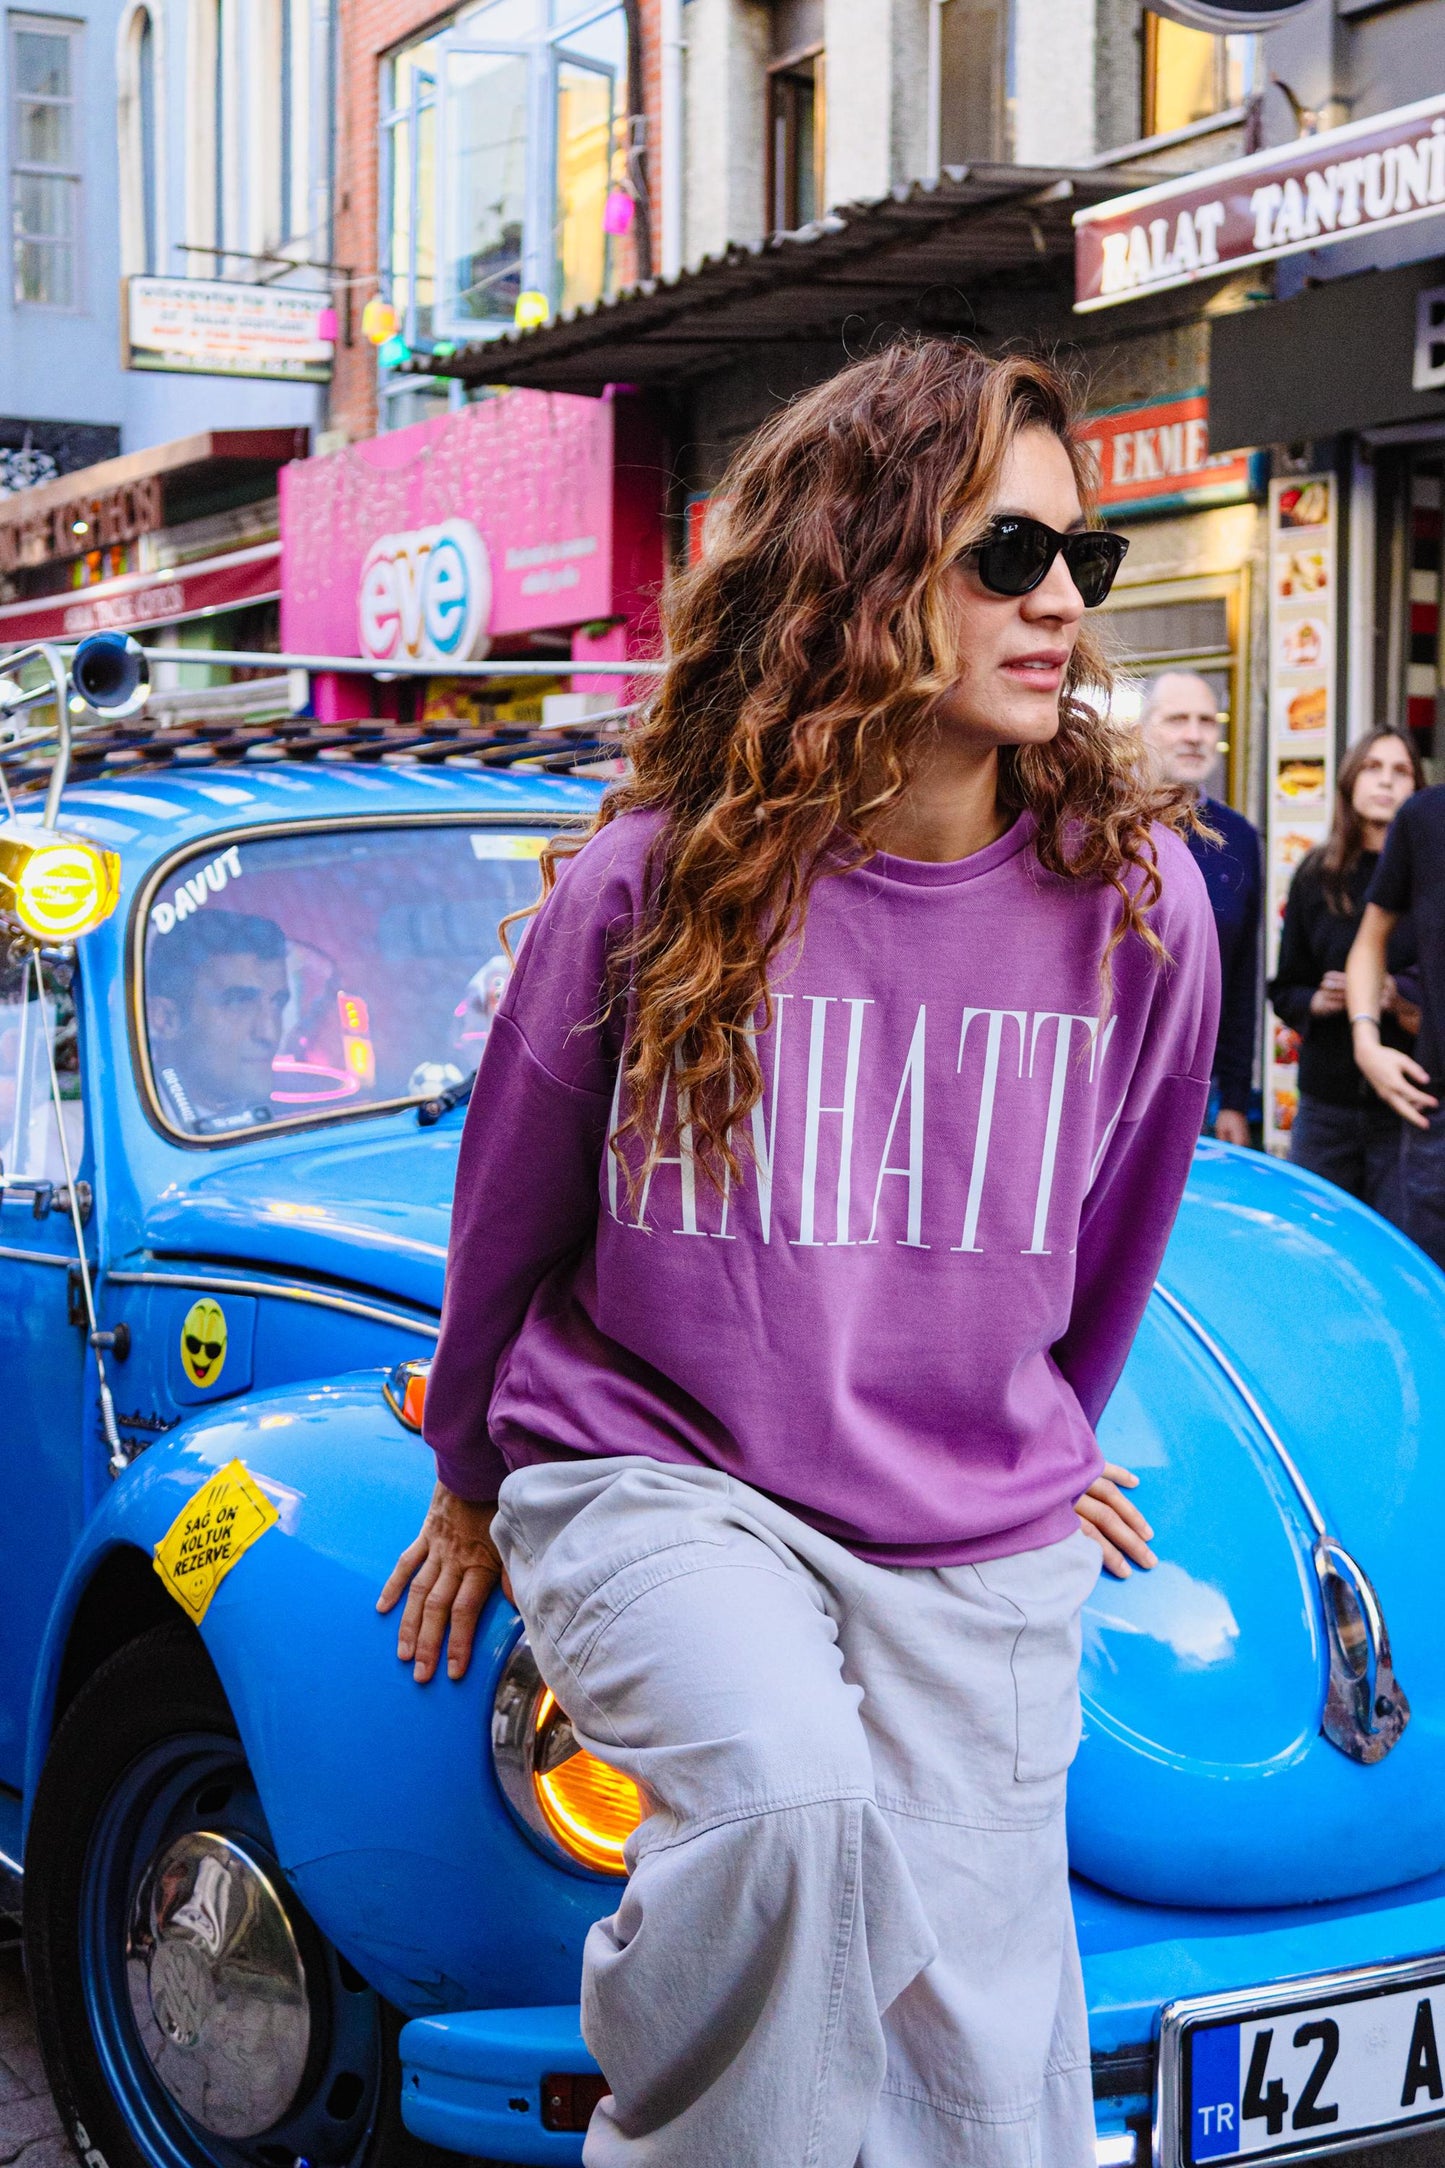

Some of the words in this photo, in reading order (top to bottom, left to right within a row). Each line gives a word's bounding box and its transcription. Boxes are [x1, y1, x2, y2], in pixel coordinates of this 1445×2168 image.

[1112, 418, 1233, 485] EKME
[358, 535, 470, 660] eve
[151, 845, 242, 935] DAVUT
[607, 988, 1126, 1256] ANHATT
[172, 1542, 232, 1578] REZERVE
[179, 1523, 234, 1557] KOLTUK
[1242, 2018, 1340, 2136] 42
[1401, 1998, 1444, 2107] A
[1198, 2103, 1234, 2136] TR
